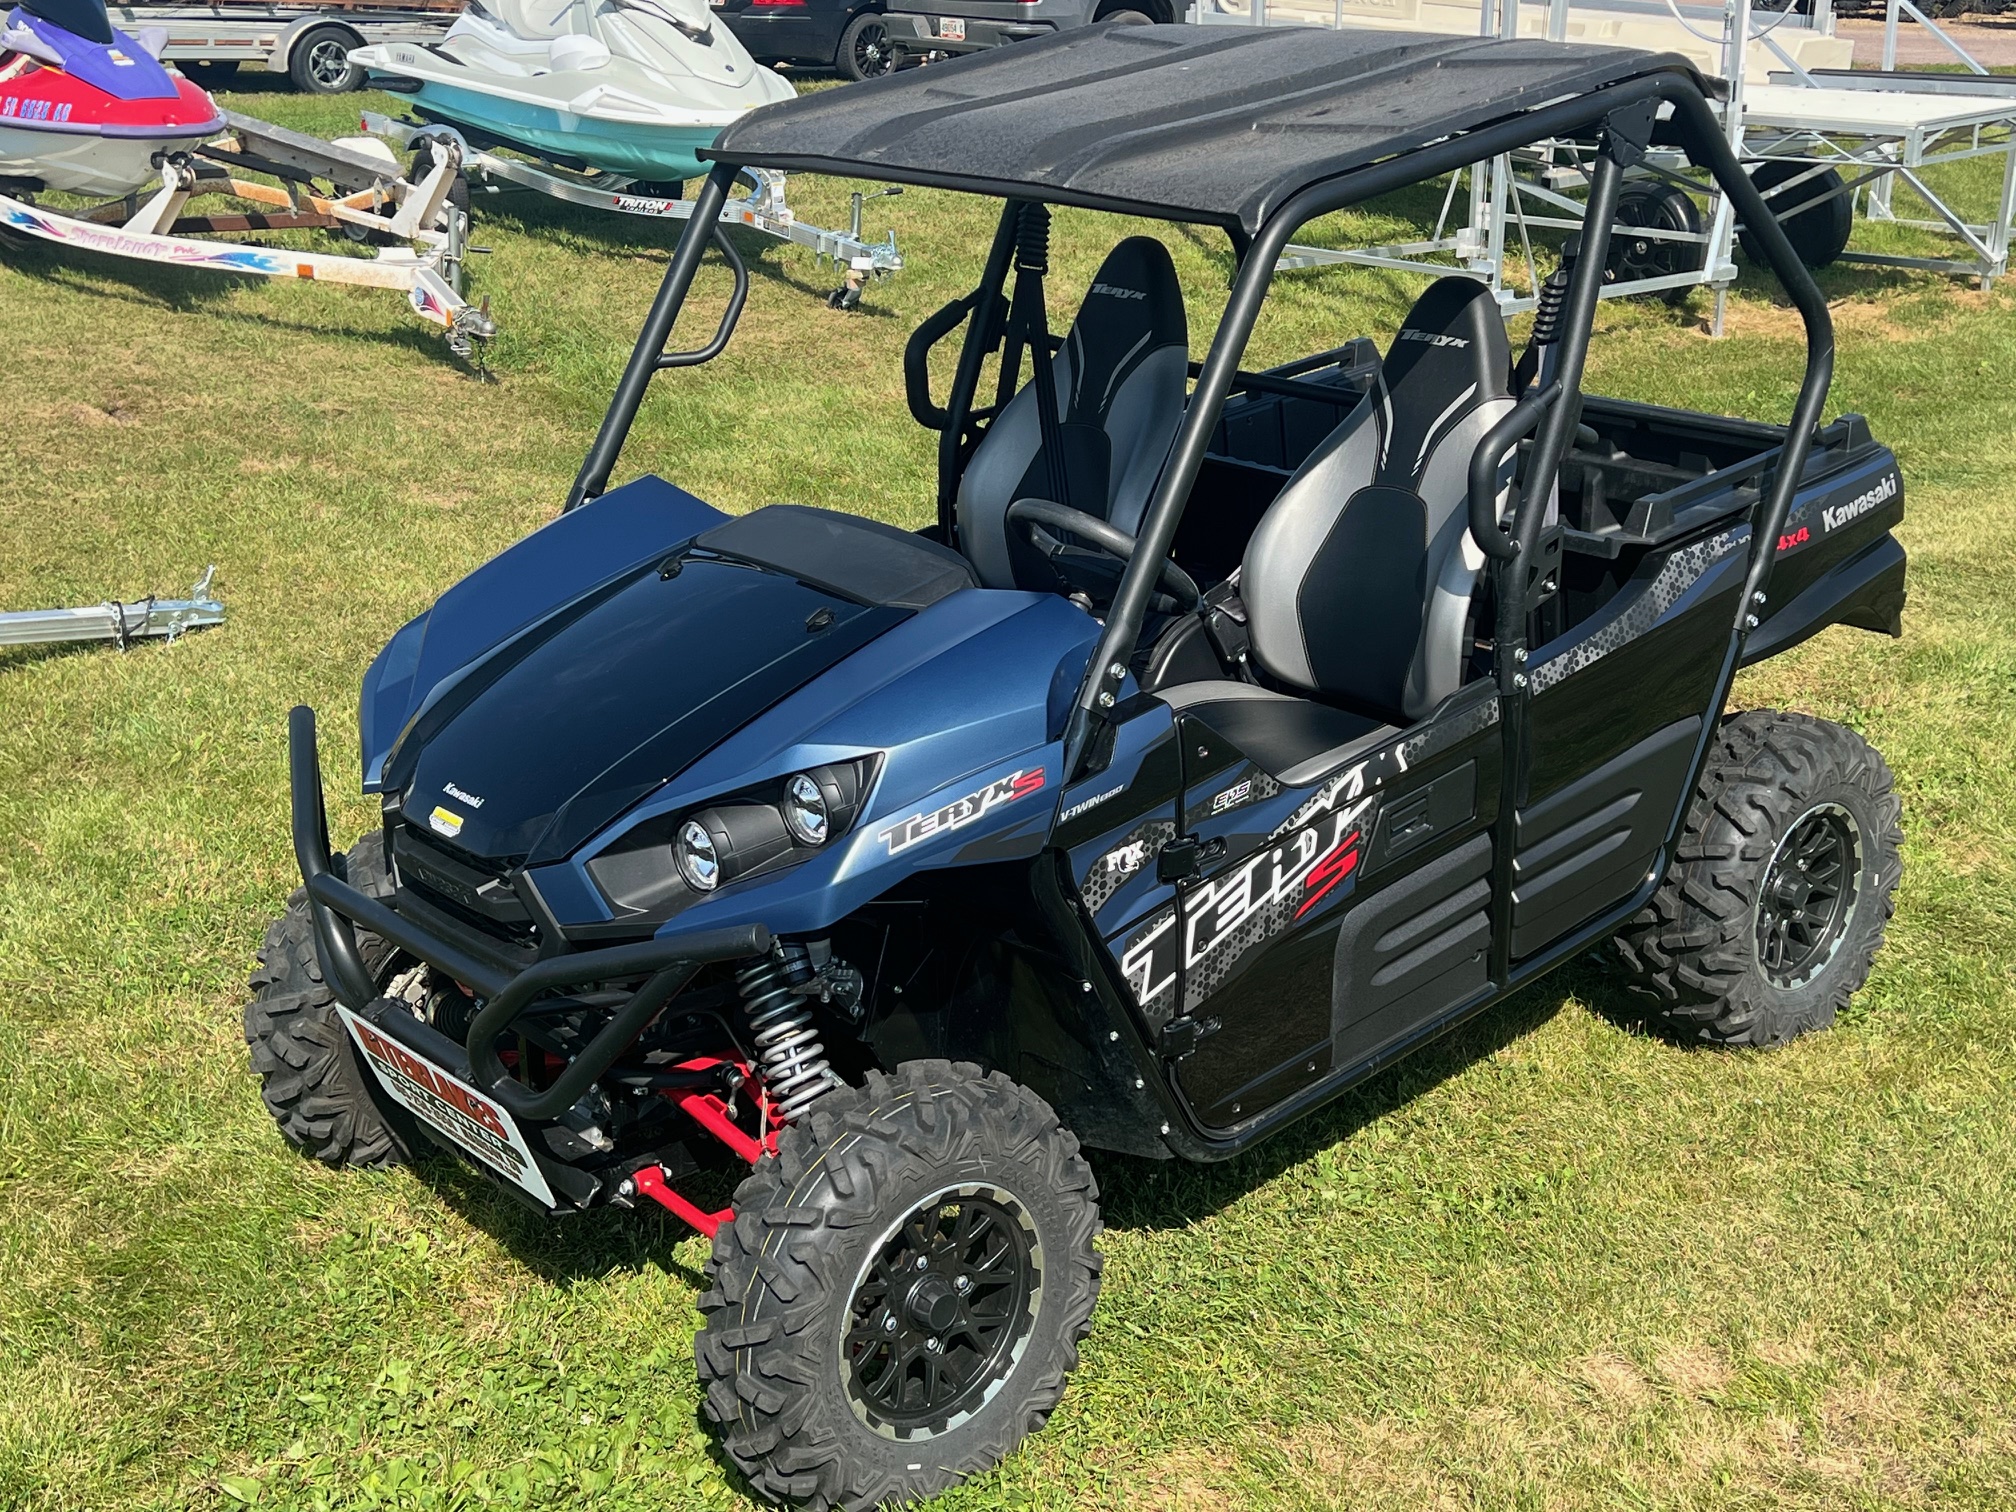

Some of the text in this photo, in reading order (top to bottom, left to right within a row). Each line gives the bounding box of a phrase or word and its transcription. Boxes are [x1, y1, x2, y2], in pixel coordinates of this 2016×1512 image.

[619, 197, 668, 210] TRITON
[1777, 473, 1897, 550] 4x4 Kawasaki
[442, 782, 485, 808] Kawasaki
[1106, 840, 1144, 873] FOX
[377, 1060, 431, 1102] SPORT
[434, 1098, 504, 1151] CENTER
